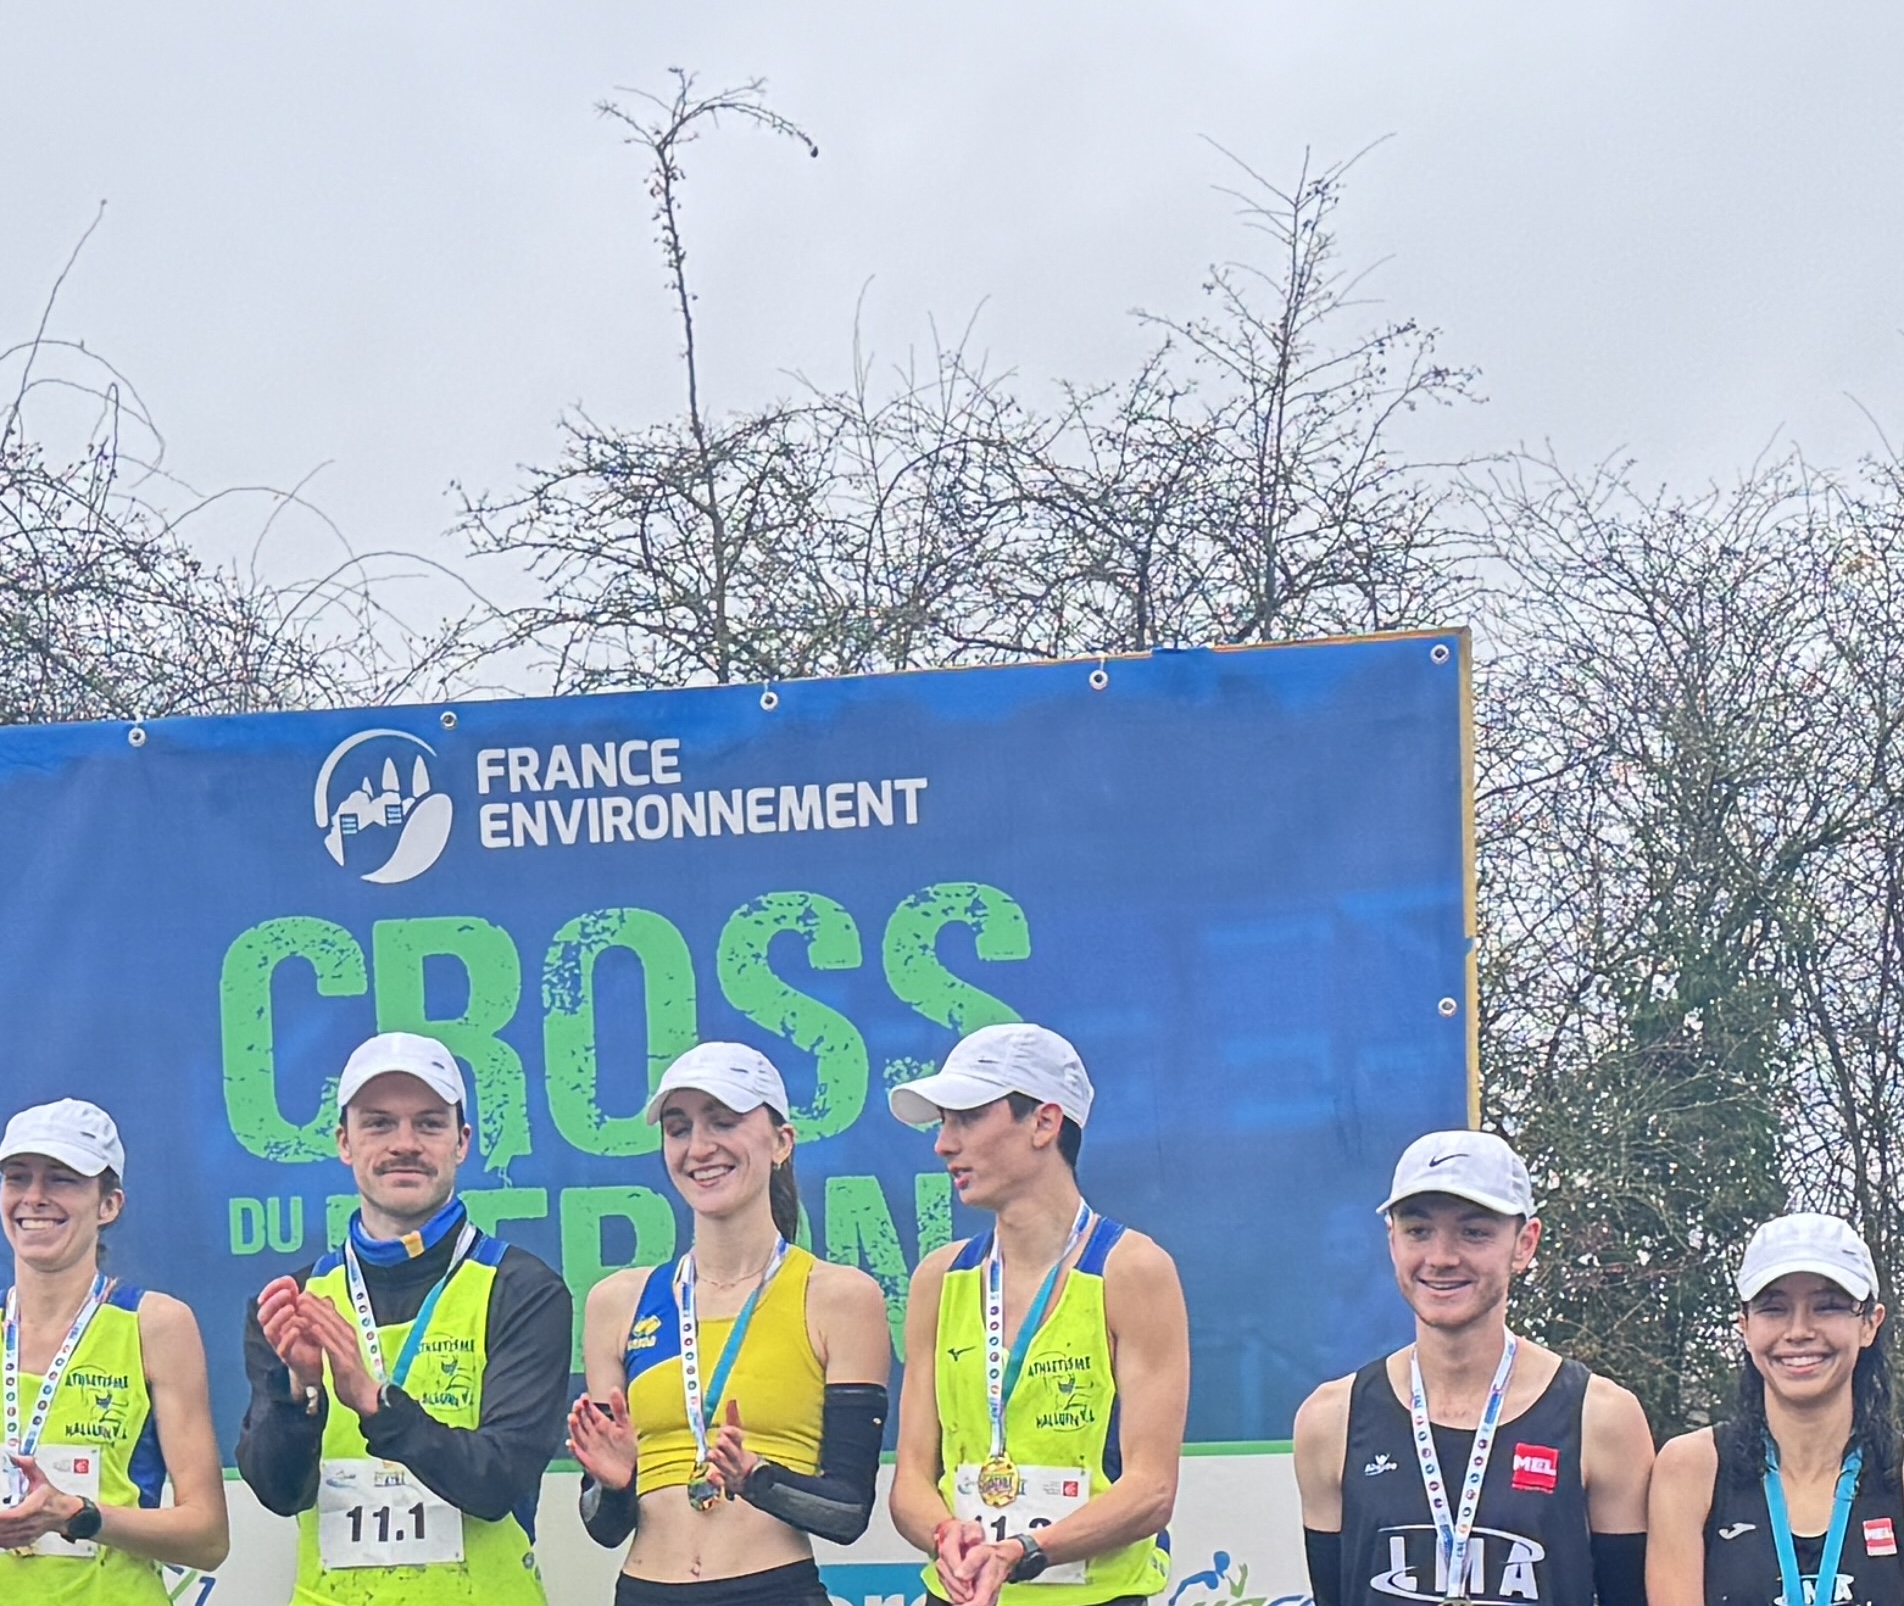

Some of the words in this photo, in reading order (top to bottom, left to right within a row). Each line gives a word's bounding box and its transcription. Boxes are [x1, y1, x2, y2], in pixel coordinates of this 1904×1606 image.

[477, 739, 682, 795] FRANCE
[478, 778, 928, 849] ENVIRONNEMENT
[220, 882, 1032, 1164] CROSS
[230, 1197, 303, 1256] DU
[1513, 1455, 1556, 1475] MEL
[346, 1502, 426, 1543] 11.1
